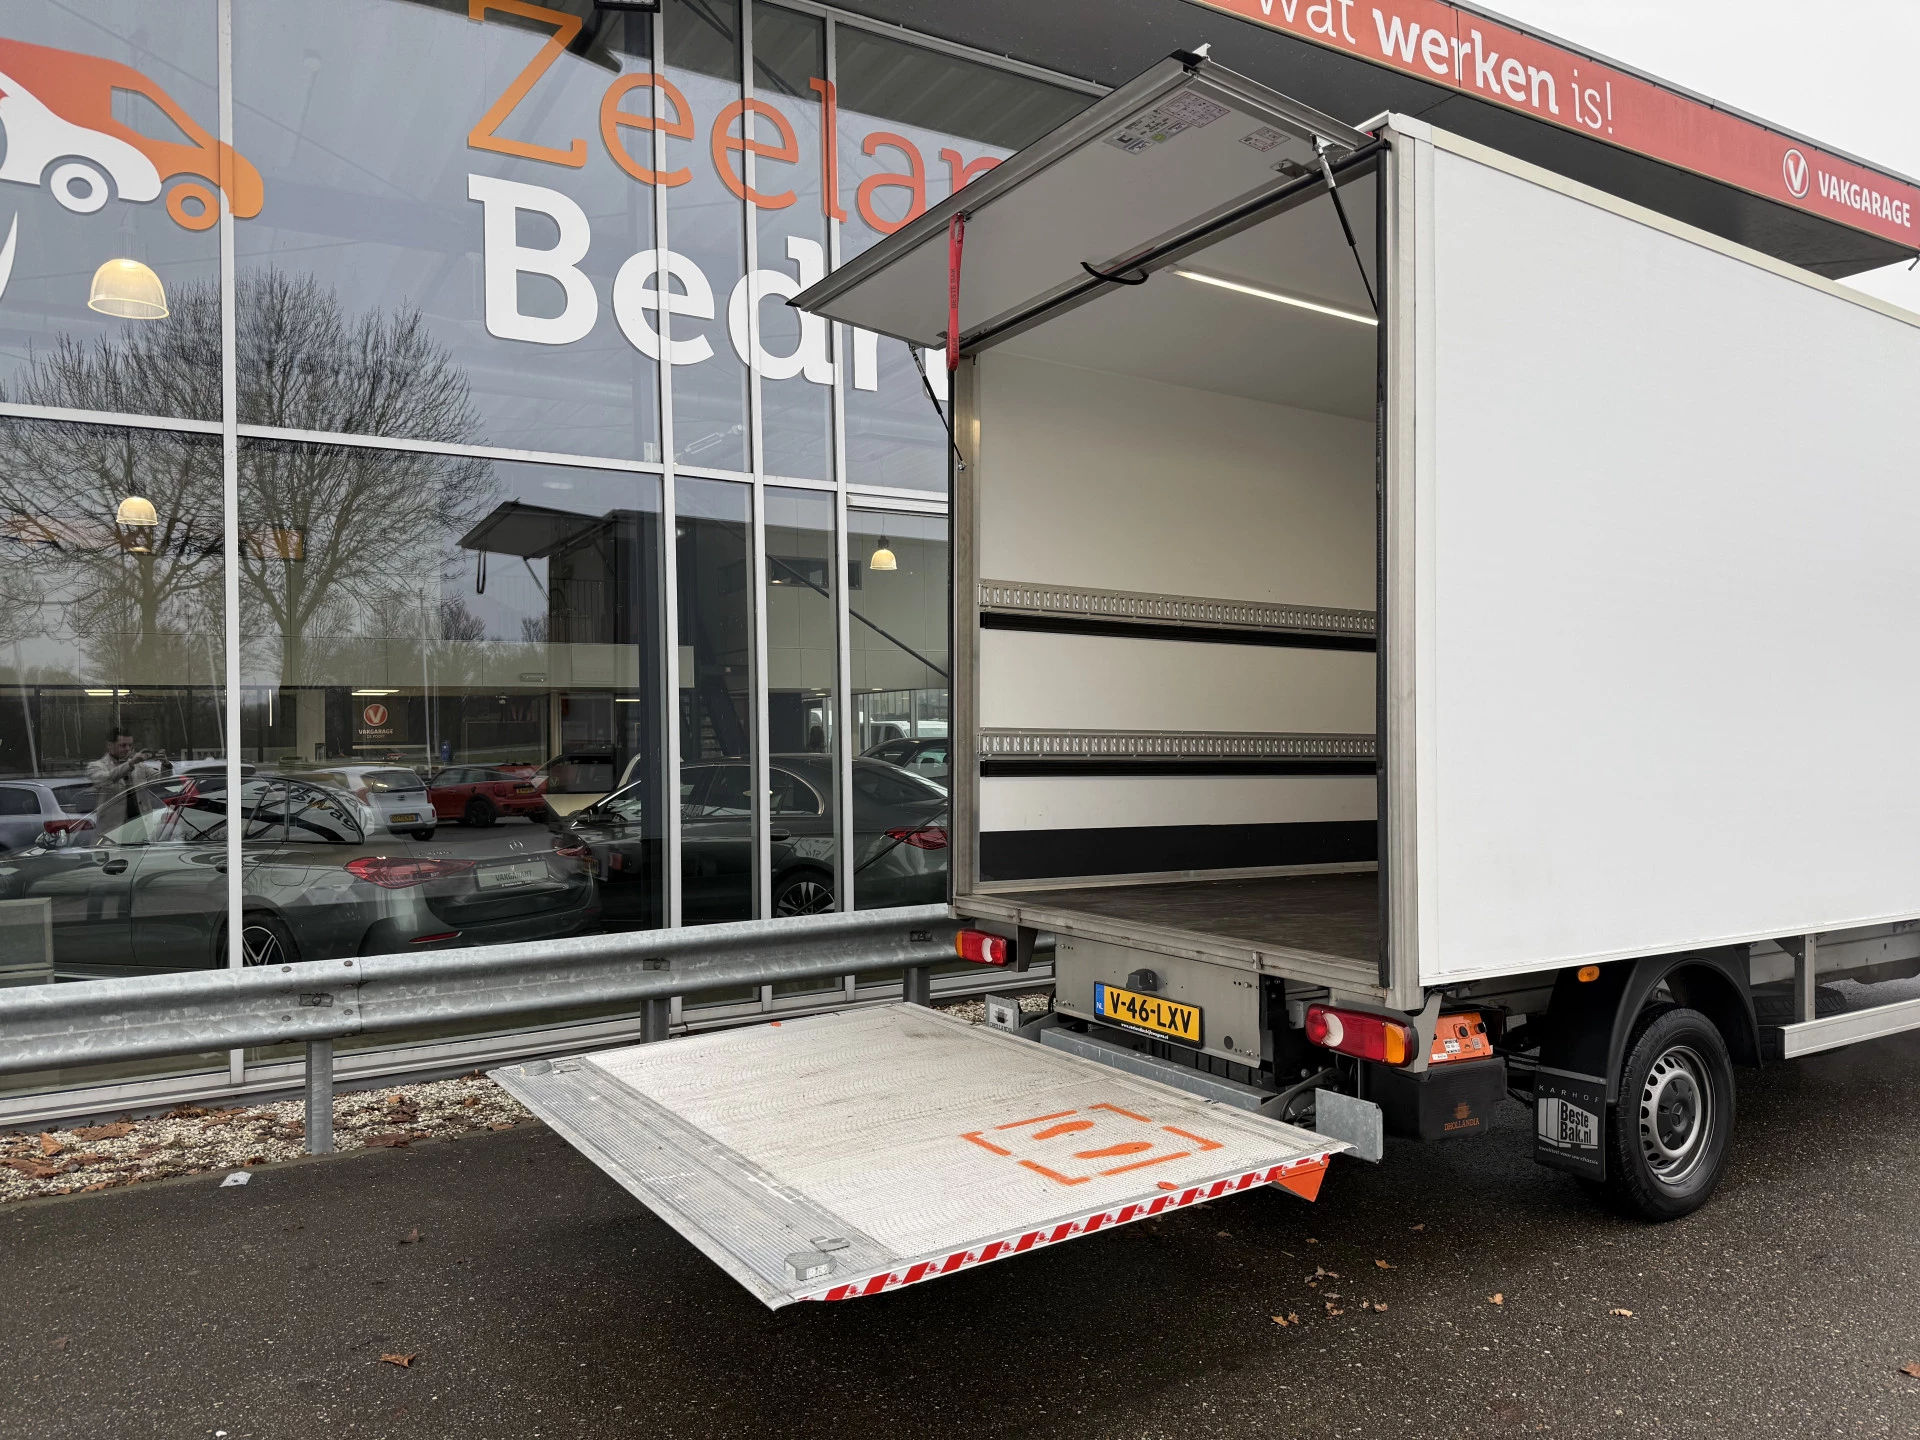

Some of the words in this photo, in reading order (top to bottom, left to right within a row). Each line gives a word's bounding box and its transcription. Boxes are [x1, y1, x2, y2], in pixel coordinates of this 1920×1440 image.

[1372, 8, 1560, 116] werken
[1571, 68, 1614, 135] is!
[1817, 170, 1911, 228] VAKGARAGE
[1096, 1001, 1104, 1010] NL
[1109, 991, 1192, 1034] V-46-LXV
[1445, 1118, 1479, 1130] DHOLLANDIA
[1561, 1102, 1588, 1128] Beste
[1561, 1121, 1591, 1144] Bak.nl
